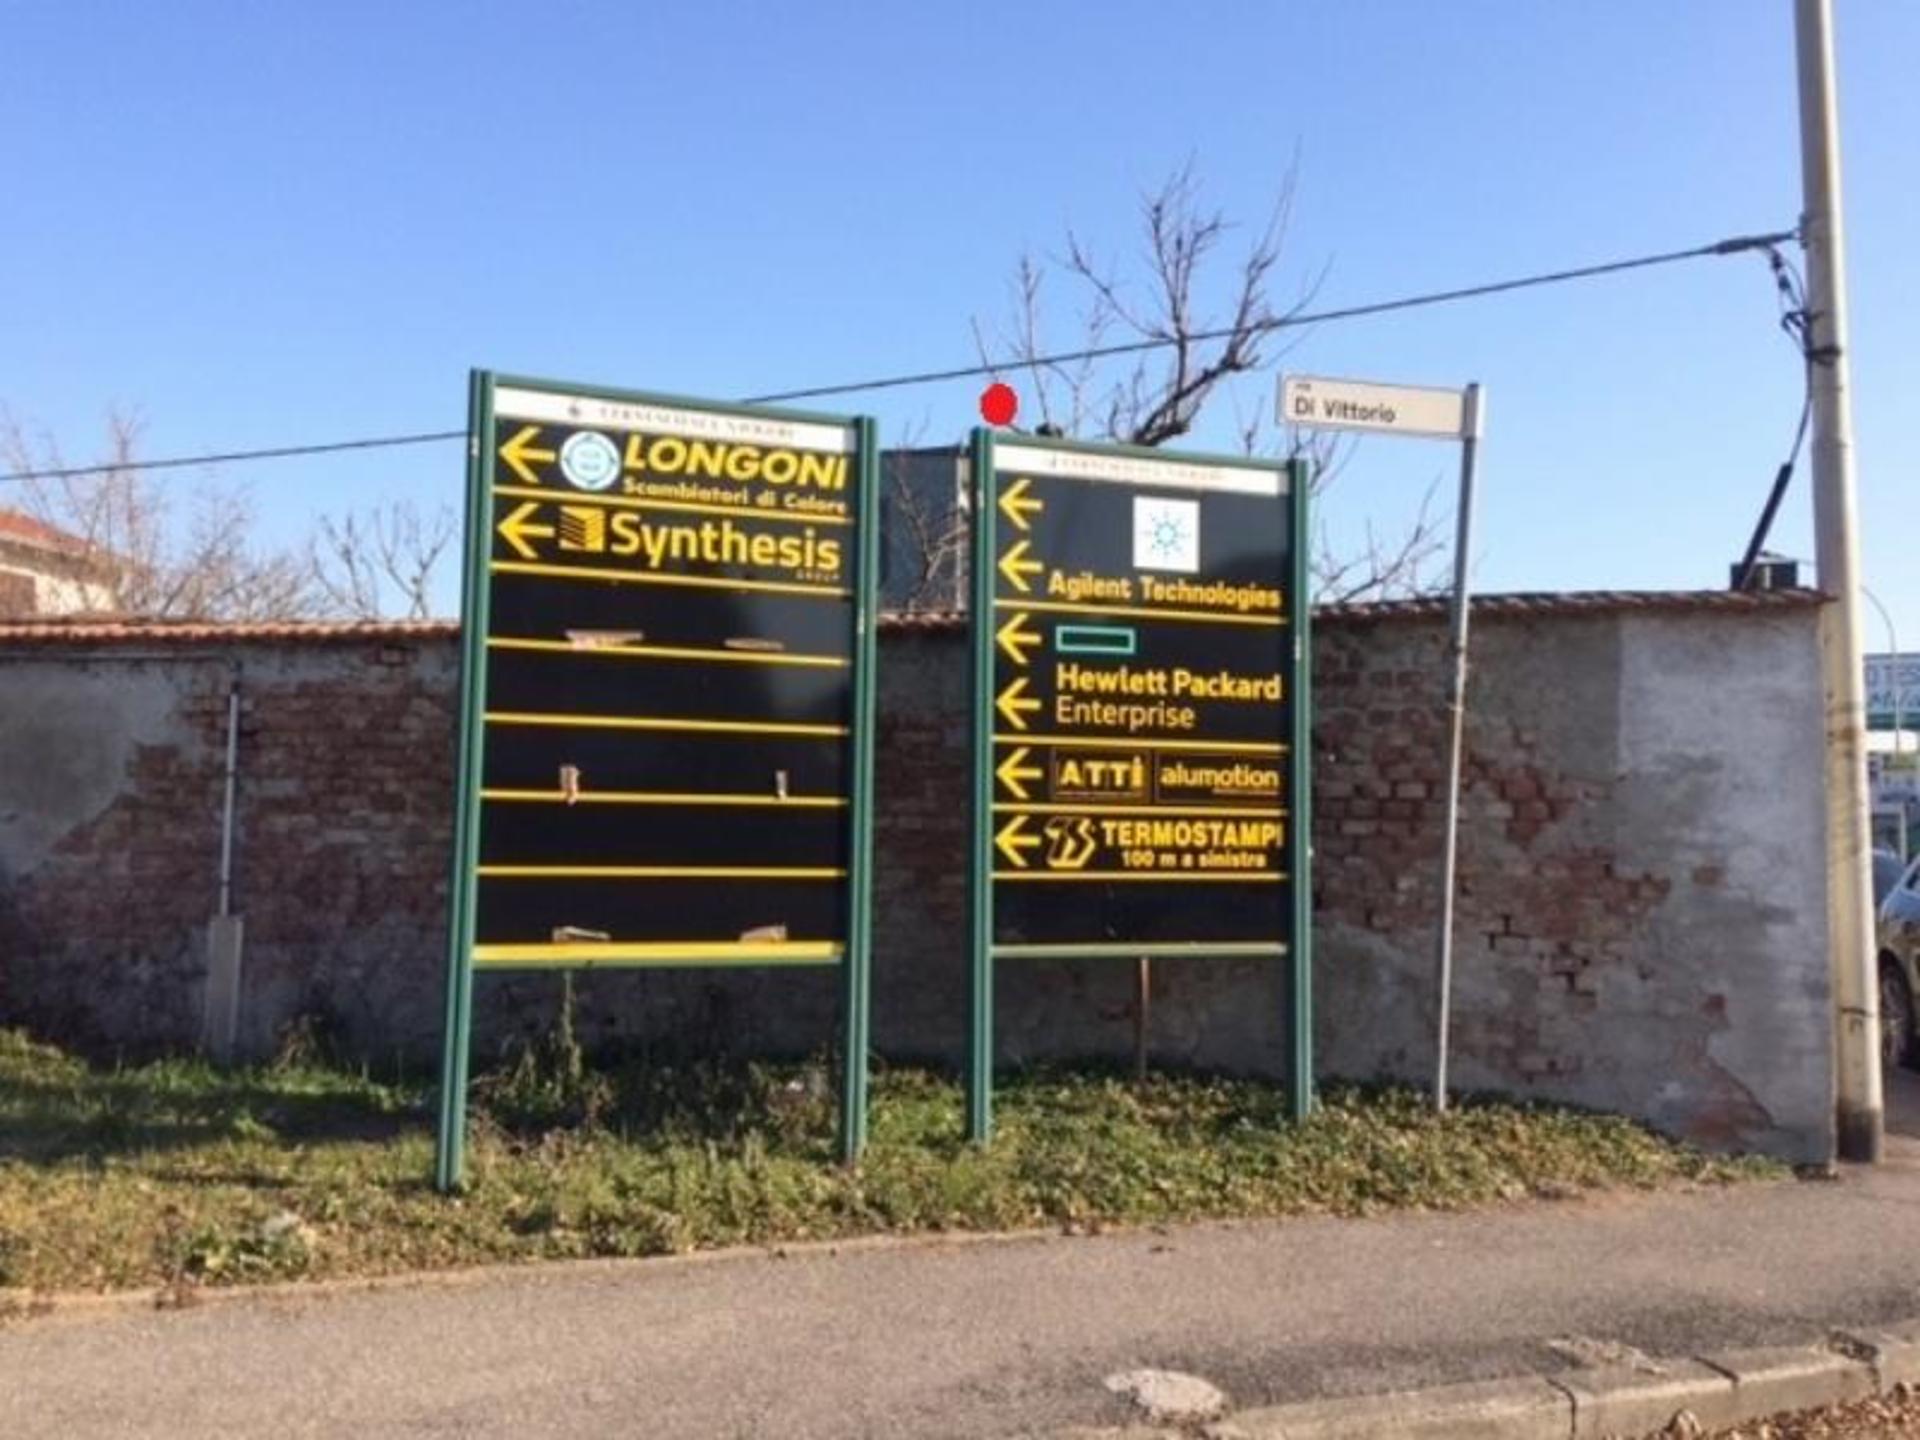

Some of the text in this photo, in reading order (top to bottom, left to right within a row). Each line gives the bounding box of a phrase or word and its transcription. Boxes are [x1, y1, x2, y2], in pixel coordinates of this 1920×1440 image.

[1294, 397, 1396, 423] Di Vittorio
[623, 434, 847, 489] LONGONI
[623, 477, 846, 514] Scambiatori di Calore
[610, 512, 840, 569] Synthesis
[1049, 569, 1282, 609] Agilent Technologies
[1056, 663, 1282, 700] Hewlett Packard
[1056, 696, 1195, 731] Enterprise
[1160, 763, 1280, 788] alumotion
[1101, 820, 1283, 848] TERMOSTAMPI
[1123, 851, 1267, 868] 100 m a sinistra
